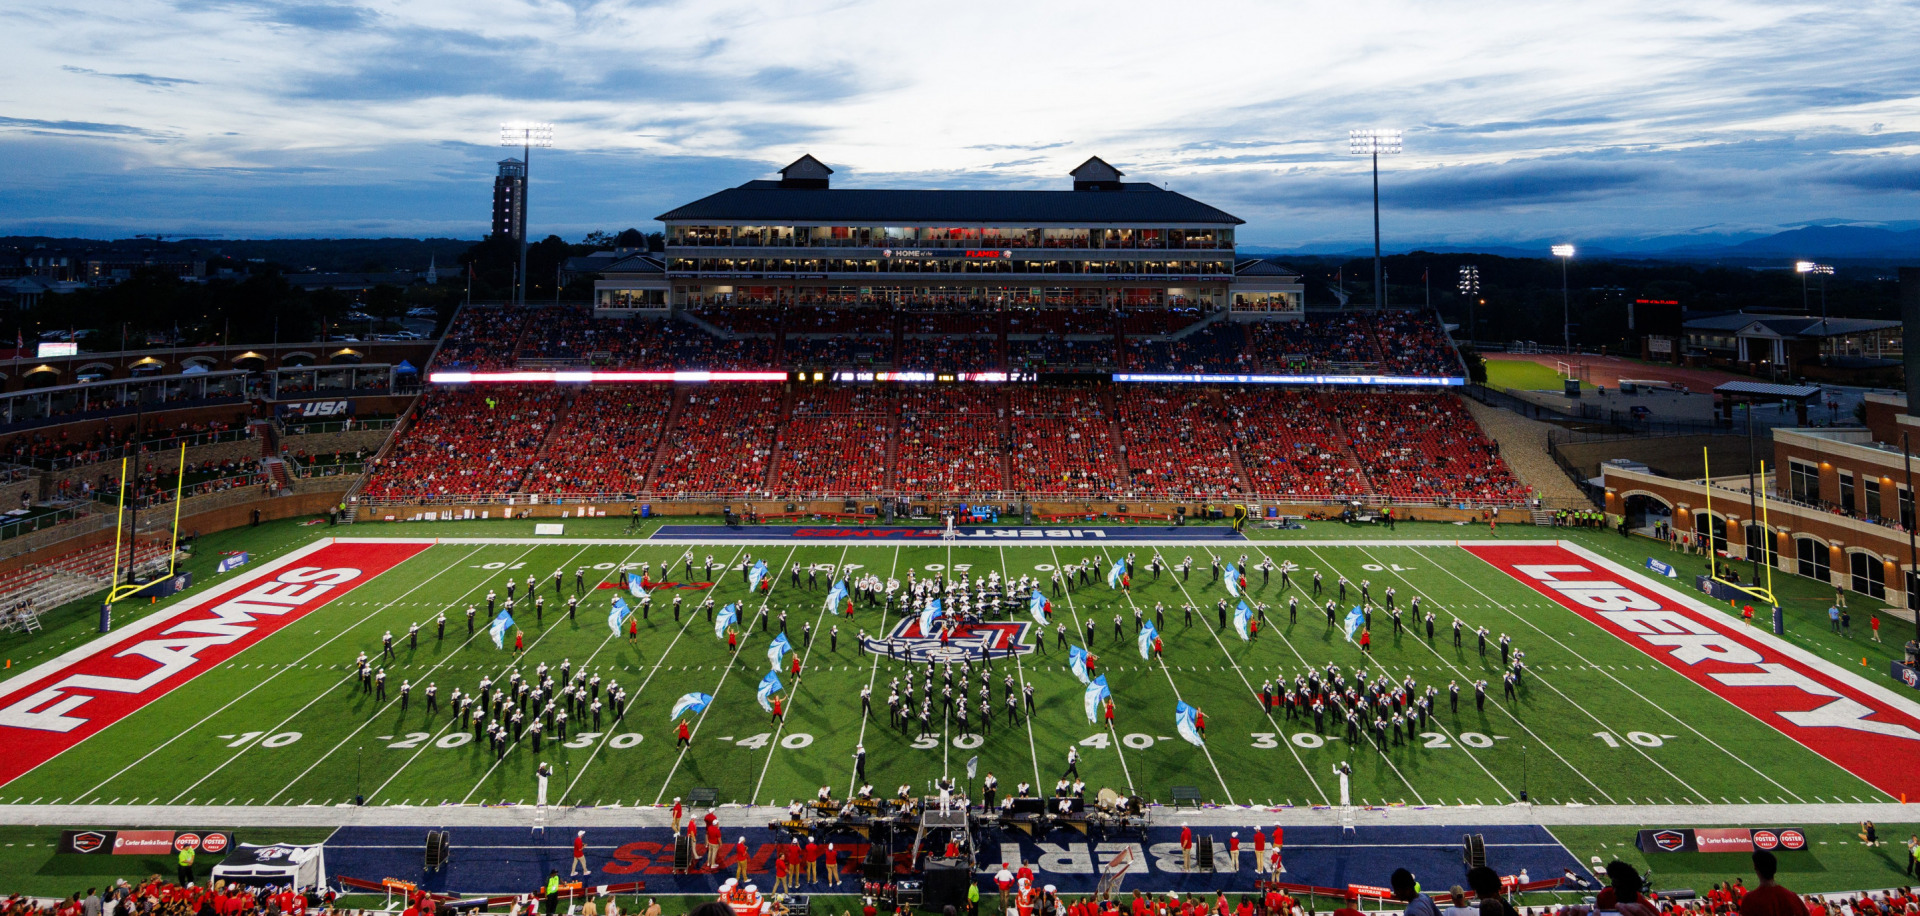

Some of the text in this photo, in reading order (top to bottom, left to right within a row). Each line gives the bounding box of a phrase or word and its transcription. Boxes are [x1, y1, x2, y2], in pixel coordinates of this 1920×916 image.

[303, 400, 348, 416] USA
[793, 529, 938, 537] FLAMES
[0, 566, 362, 732] FLAMES
[1512, 564, 1920, 741] LIBERTY
[226, 731, 303, 748] 10
[387, 732, 473, 748] 20
[563, 732, 644, 748] 30
[735, 732, 814, 749] 40
[909, 733, 985, 750] 50
[1078, 732, 1155, 749] 40
[1250, 732, 1326, 749] 30
[1418, 732, 1496, 749] 20
[1592, 732, 1664, 748] 10
